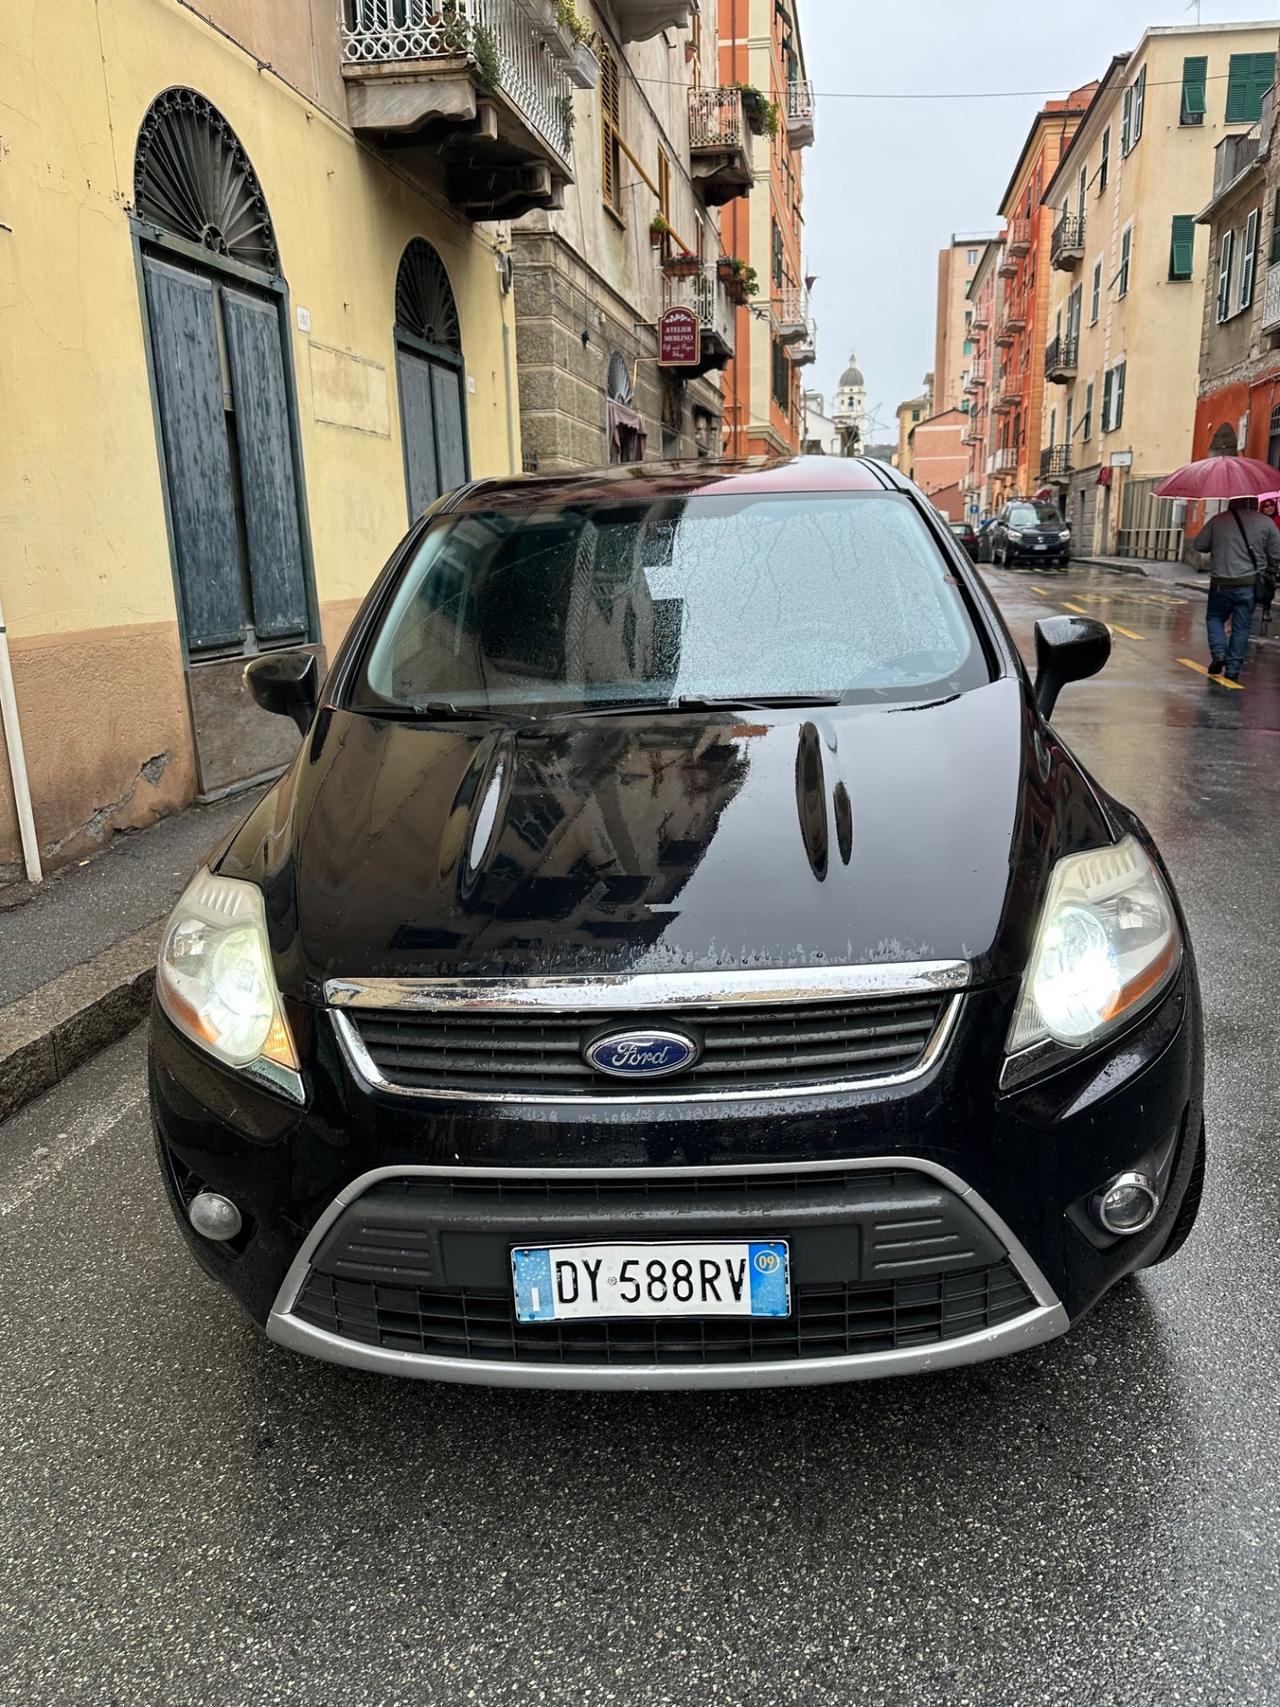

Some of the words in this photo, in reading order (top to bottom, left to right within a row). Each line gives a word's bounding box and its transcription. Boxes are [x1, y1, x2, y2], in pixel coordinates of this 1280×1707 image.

[612, 1041, 672, 1066] Ford
[757, 1254, 775, 1270] 09
[555, 1259, 602, 1304] DY
[619, 1258, 746, 1303] 588RV
